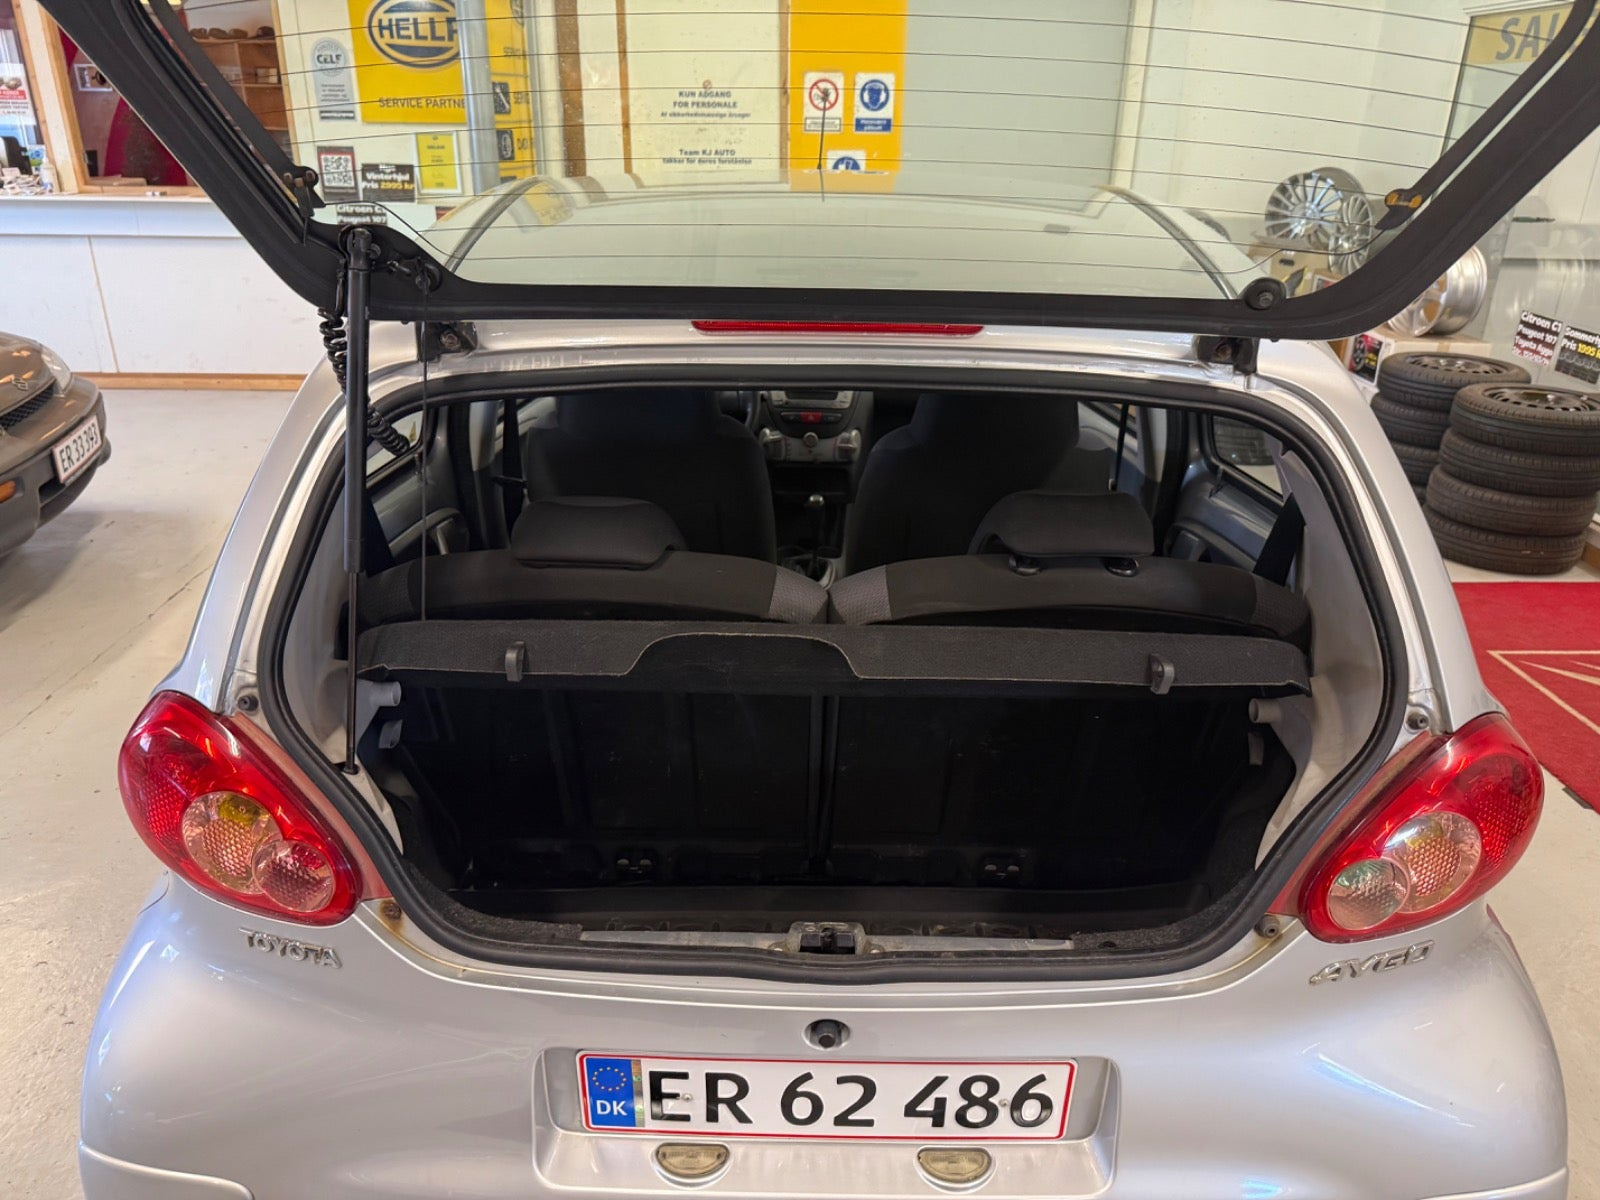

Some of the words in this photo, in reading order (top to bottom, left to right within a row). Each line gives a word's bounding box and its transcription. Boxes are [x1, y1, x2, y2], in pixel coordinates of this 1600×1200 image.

[678, 90, 696, 98] KUN
[698, 90, 731, 98] ADGANG
[379, 97, 423, 108] SERVICE
[673, 101, 689, 109] FOR
[691, 101, 737, 109] PERSONALE
[366, 172, 410, 182] Vinterhjul
[362, 181, 379, 189] Pris
[1551, 321, 1562, 332] C1
[1515, 335, 1537, 350] Toyota
[1561, 338, 1577, 351] Pris
[59, 445, 75, 473] ER
[73, 435, 85, 462] 33
[84, 422, 98, 452] 393
[239, 927, 343, 969] TOYOTA
[1309, 939, 1435, 984] AYGO
[649, 1070, 753, 1124] ER
[781, 1071, 877, 1127] 62
[904, 1073, 1054, 1129] 486
[596, 1100, 627, 1116] DK
